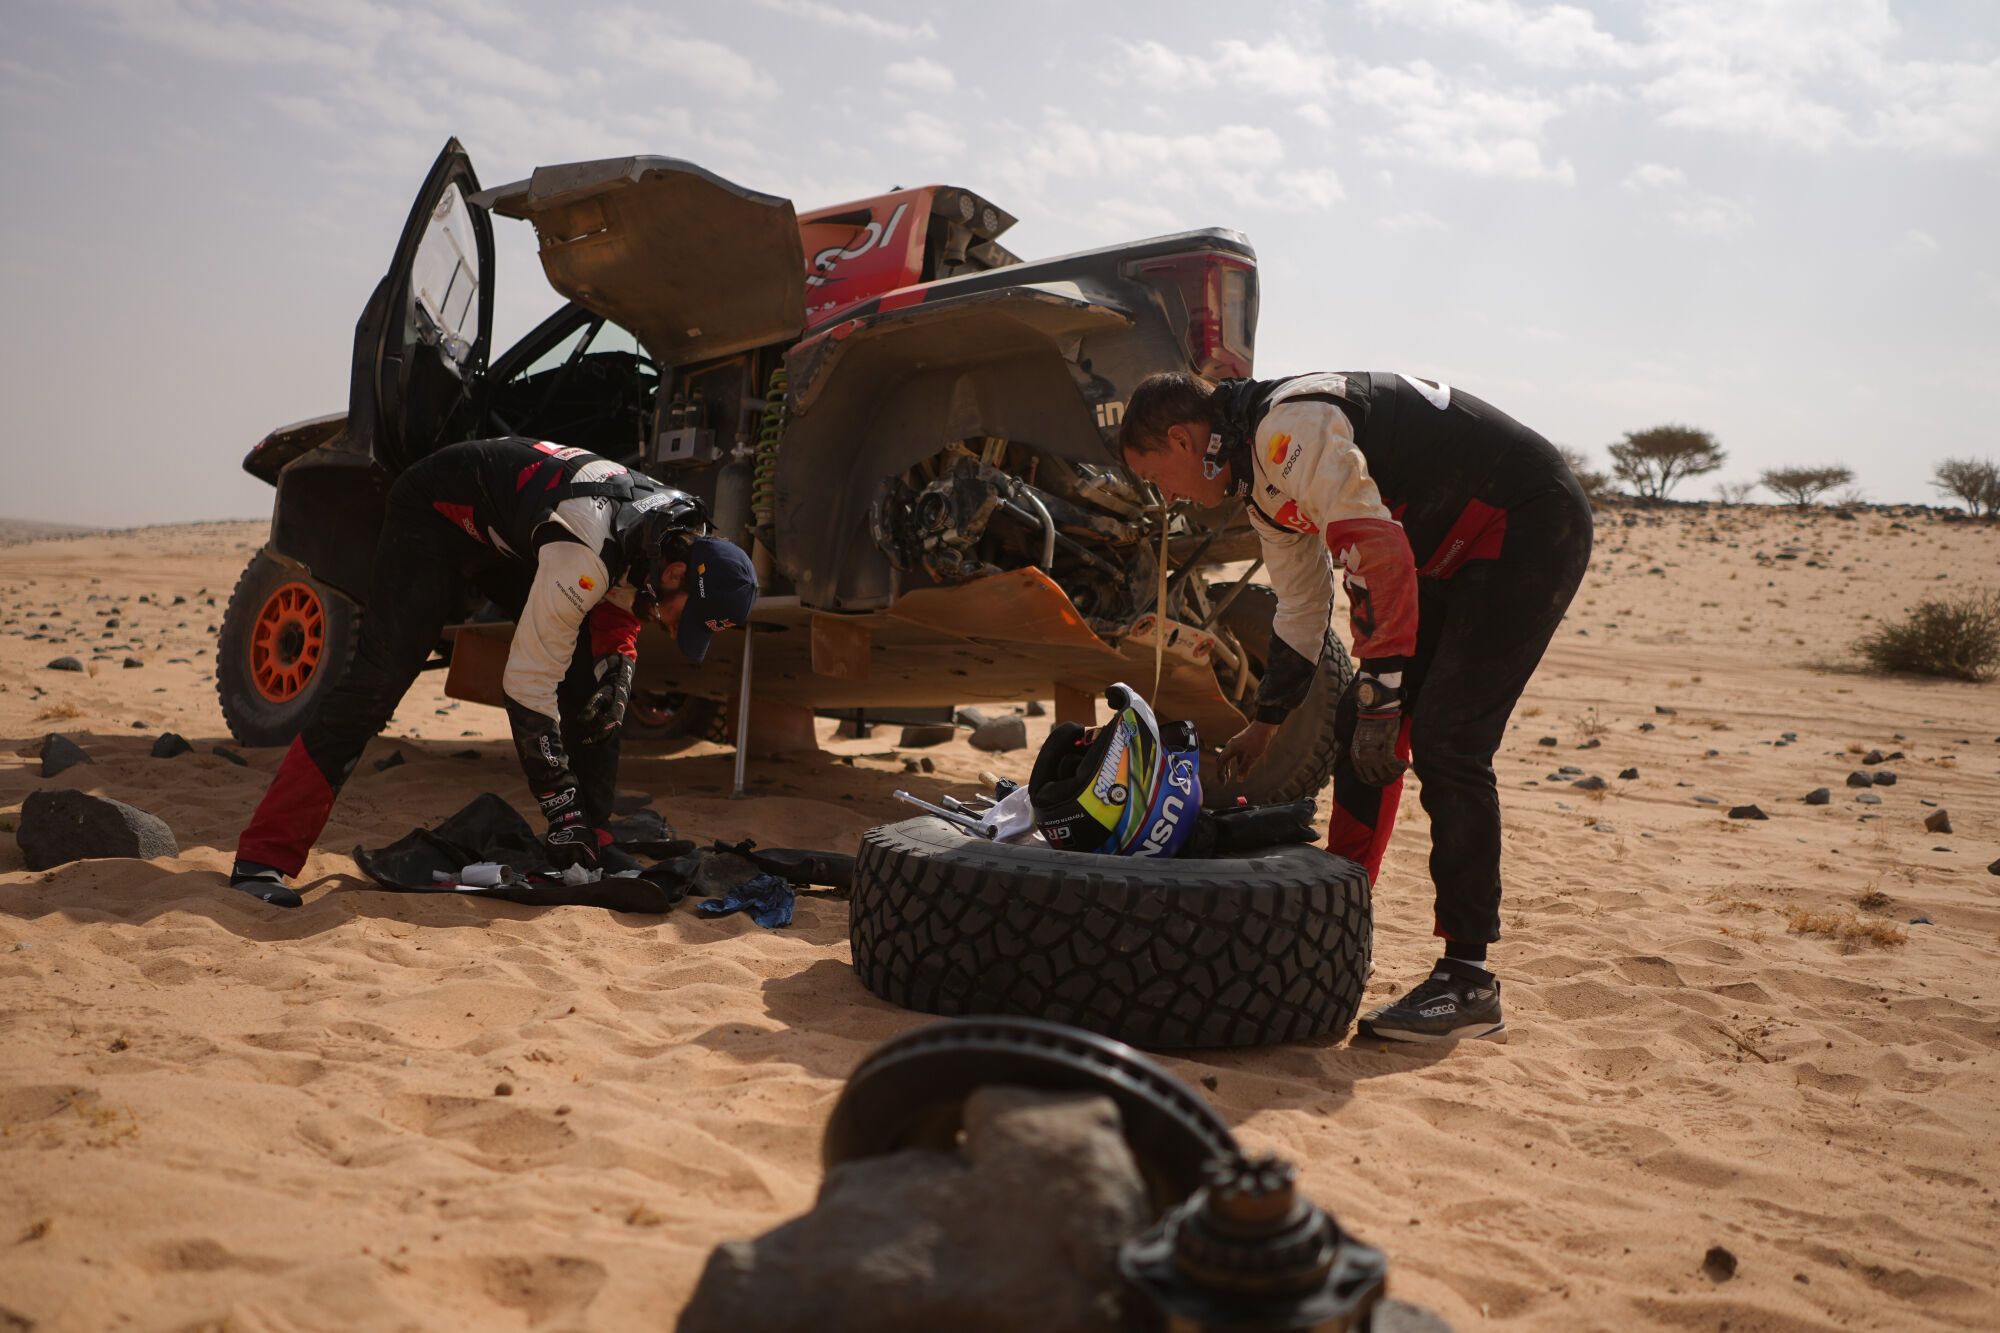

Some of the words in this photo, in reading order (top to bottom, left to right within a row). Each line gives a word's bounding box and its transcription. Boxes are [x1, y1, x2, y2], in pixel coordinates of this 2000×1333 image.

[1281, 444, 1303, 480] repsol
[699, 577, 707, 599] repsol
[540, 735, 559, 767] sparco
[1047, 826, 1071, 840] GR
[1419, 1003, 1456, 1018] sparco
